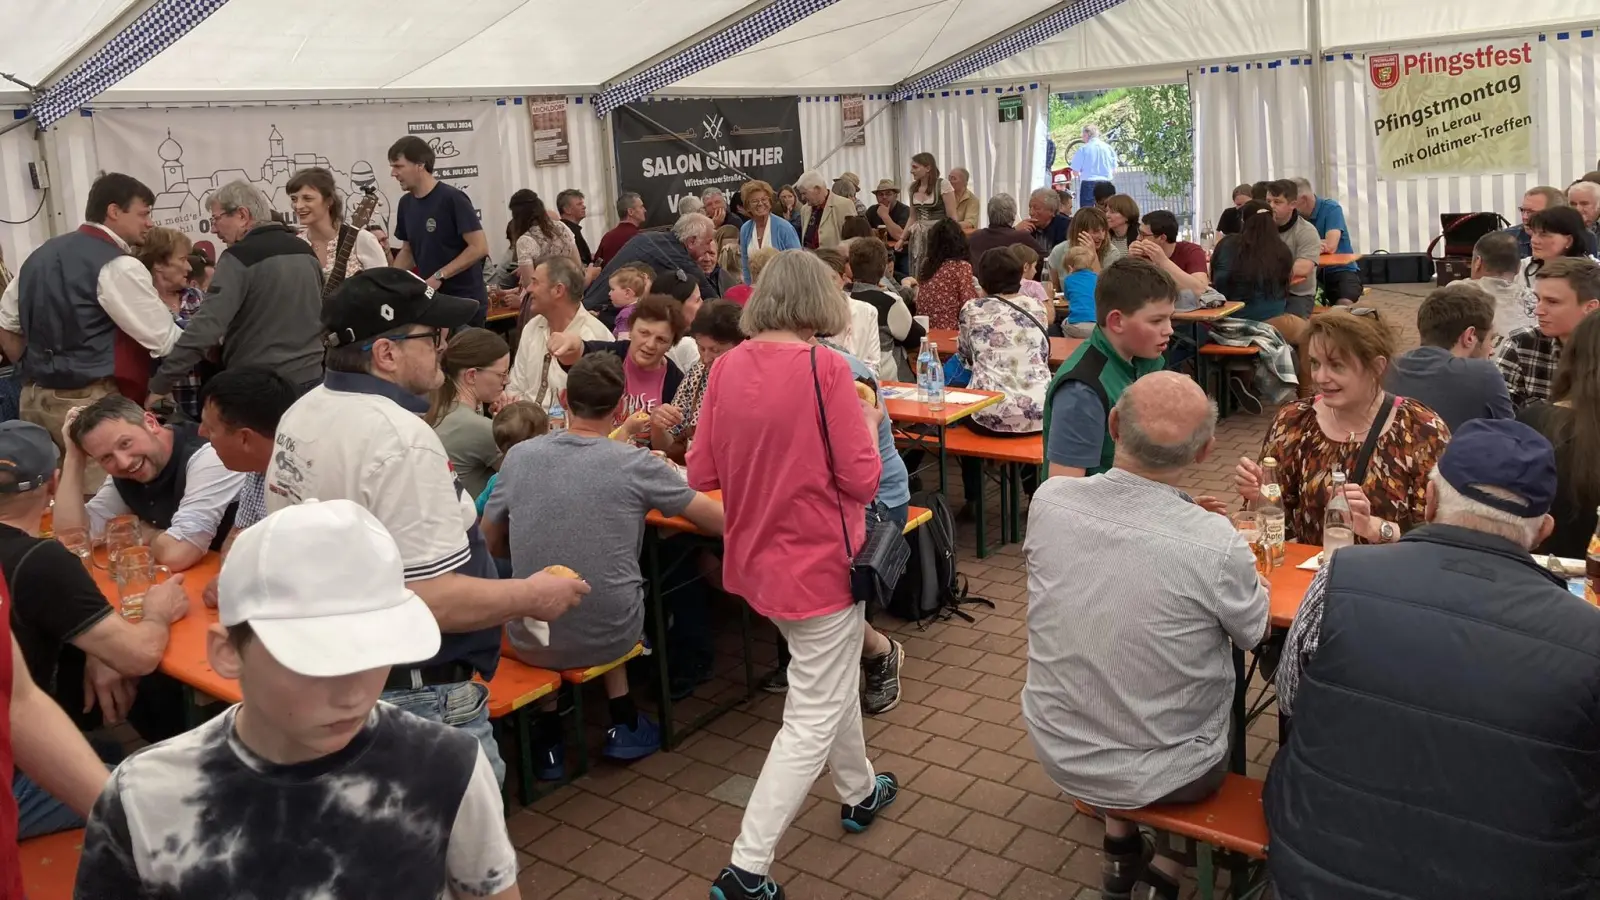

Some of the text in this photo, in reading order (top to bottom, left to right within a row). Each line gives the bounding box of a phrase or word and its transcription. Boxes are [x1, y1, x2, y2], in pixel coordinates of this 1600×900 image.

[1404, 43, 1532, 76] Pfingstfest
[1374, 74, 1521, 136] Pfingstmontag
[408, 123, 435, 131] FREITAG,
[458, 121, 472, 129] 2024
[1426, 111, 1482, 138] in Lerau
[1392, 114, 1532, 169] mit Oldtimer-Treffen
[463, 167, 478, 175] 2024
[642, 145, 783, 178] SALON GÜNTHER
